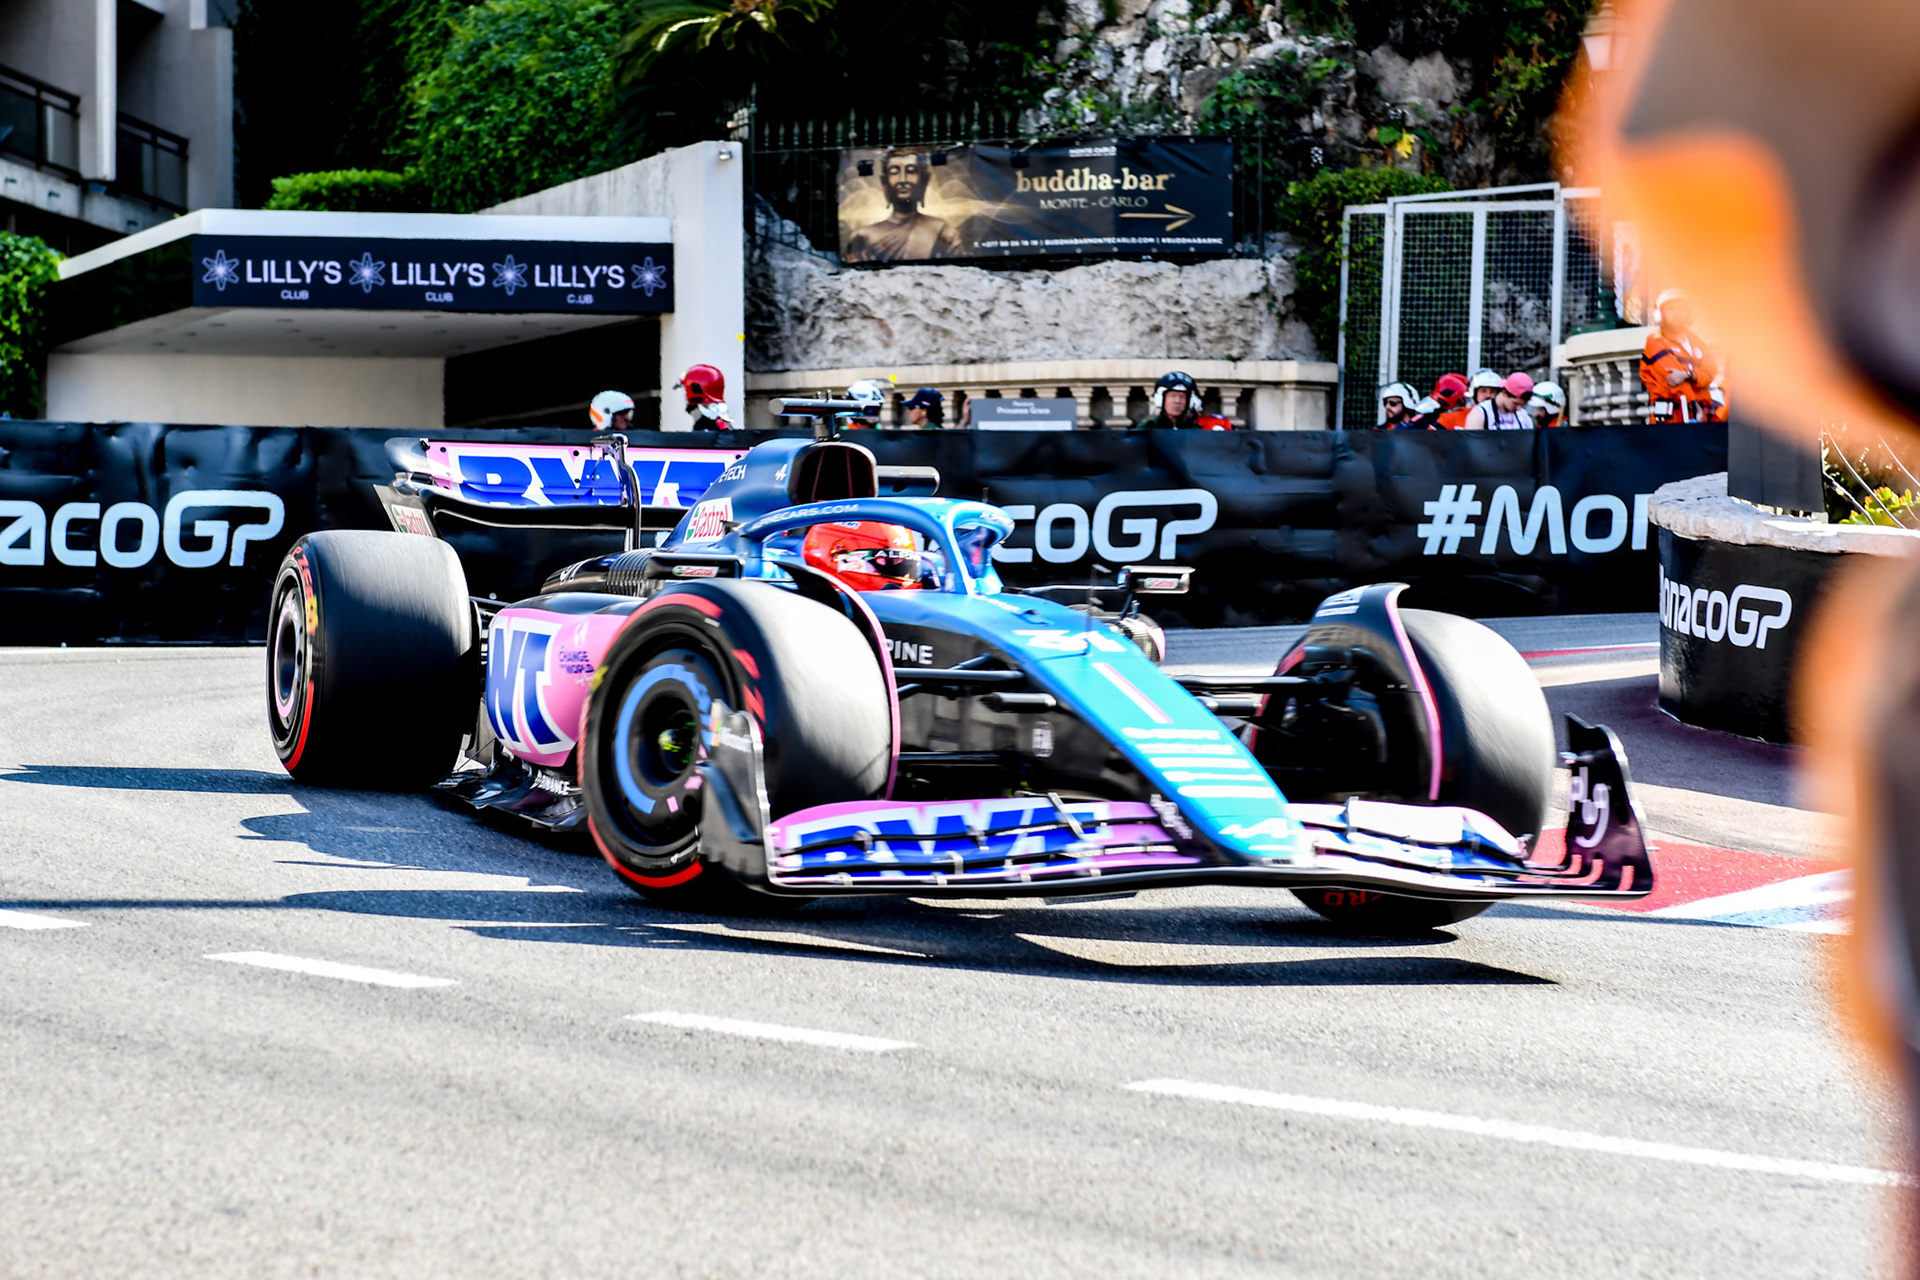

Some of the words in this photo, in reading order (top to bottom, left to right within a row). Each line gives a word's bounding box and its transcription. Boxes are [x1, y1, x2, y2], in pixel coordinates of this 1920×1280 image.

[1015, 167, 1170, 192] buddha-bar
[246, 259, 342, 285] LILLY'S
[391, 262, 486, 287] LILLY'S
[534, 264, 626, 289] LILLY'S
[280, 289, 310, 301] CLUB
[424, 291, 455, 303] CLUB
